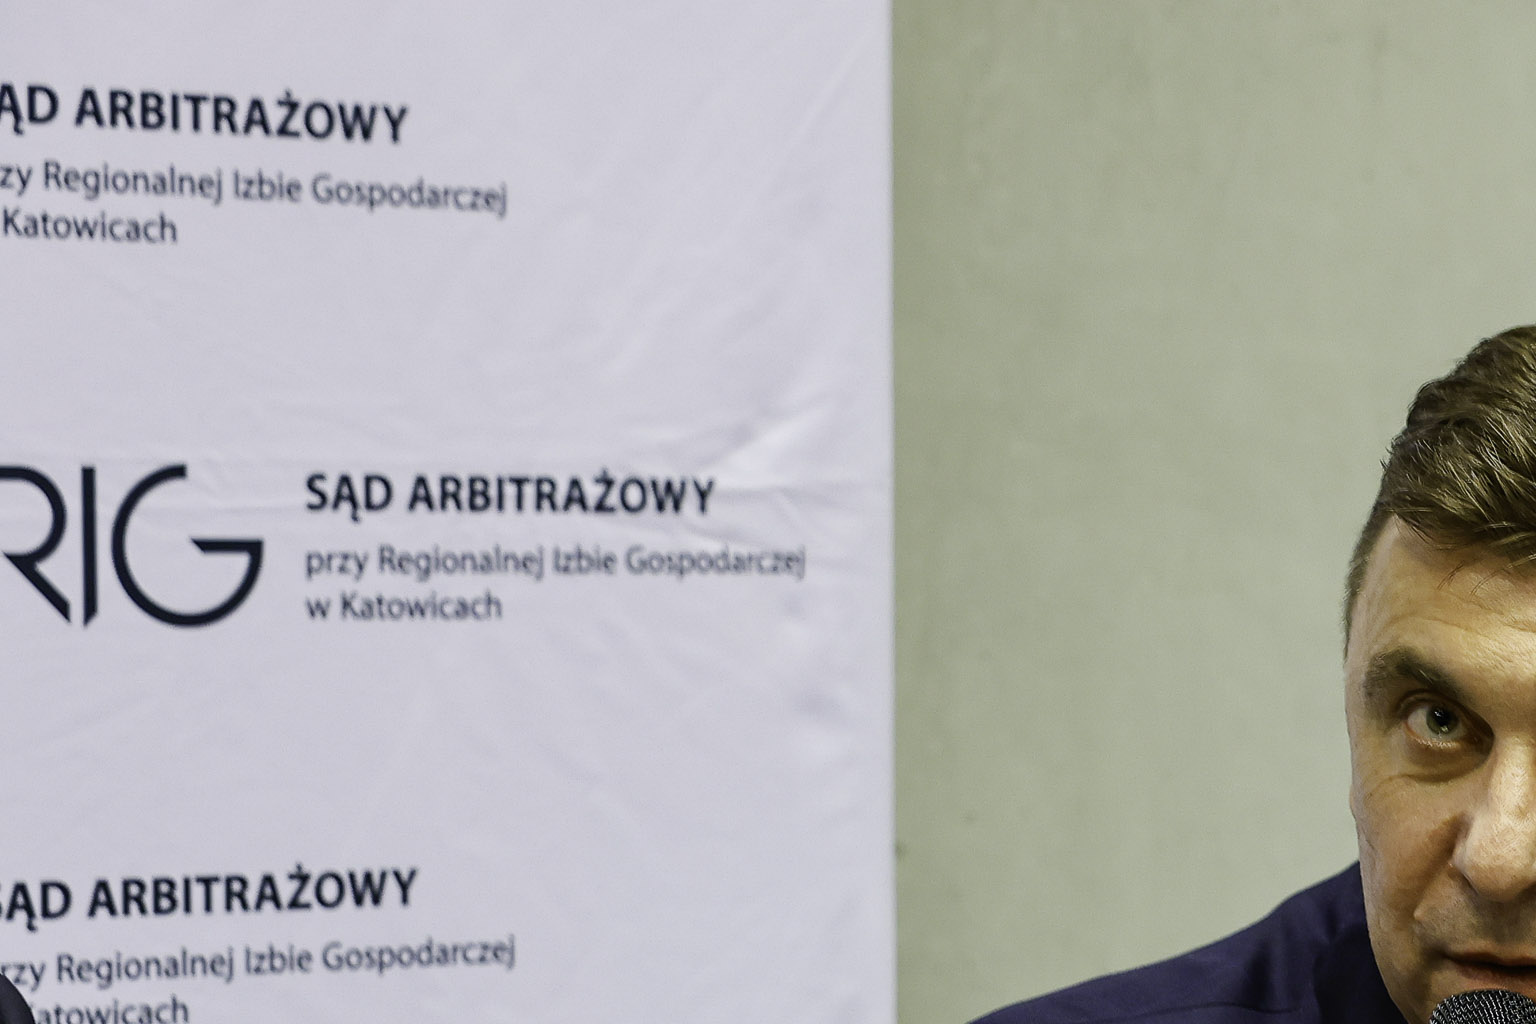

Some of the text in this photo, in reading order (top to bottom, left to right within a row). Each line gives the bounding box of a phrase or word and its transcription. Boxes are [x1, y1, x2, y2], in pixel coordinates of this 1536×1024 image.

[0, 82, 409, 146] ĄD ARBITRAŻOWY
[0, 159, 507, 219] zy Regionalnej Izbie Gospodarczej
[2, 206, 178, 244] Katowicach
[305, 467, 716, 525] SĄD ARBITRAŻOWY
[305, 544, 806, 583] przy Regionalnej Izbie Gospodarczej
[305, 592, 502, 622] w Katowicach
[0, 862, 419, 934] ĄD ARBITRAŻOWY
[56, 946, 235, 990] Regionalnej
[244, 942, 313, 977] Izbie
[321, 936, 516, 976] Gospodarczej
